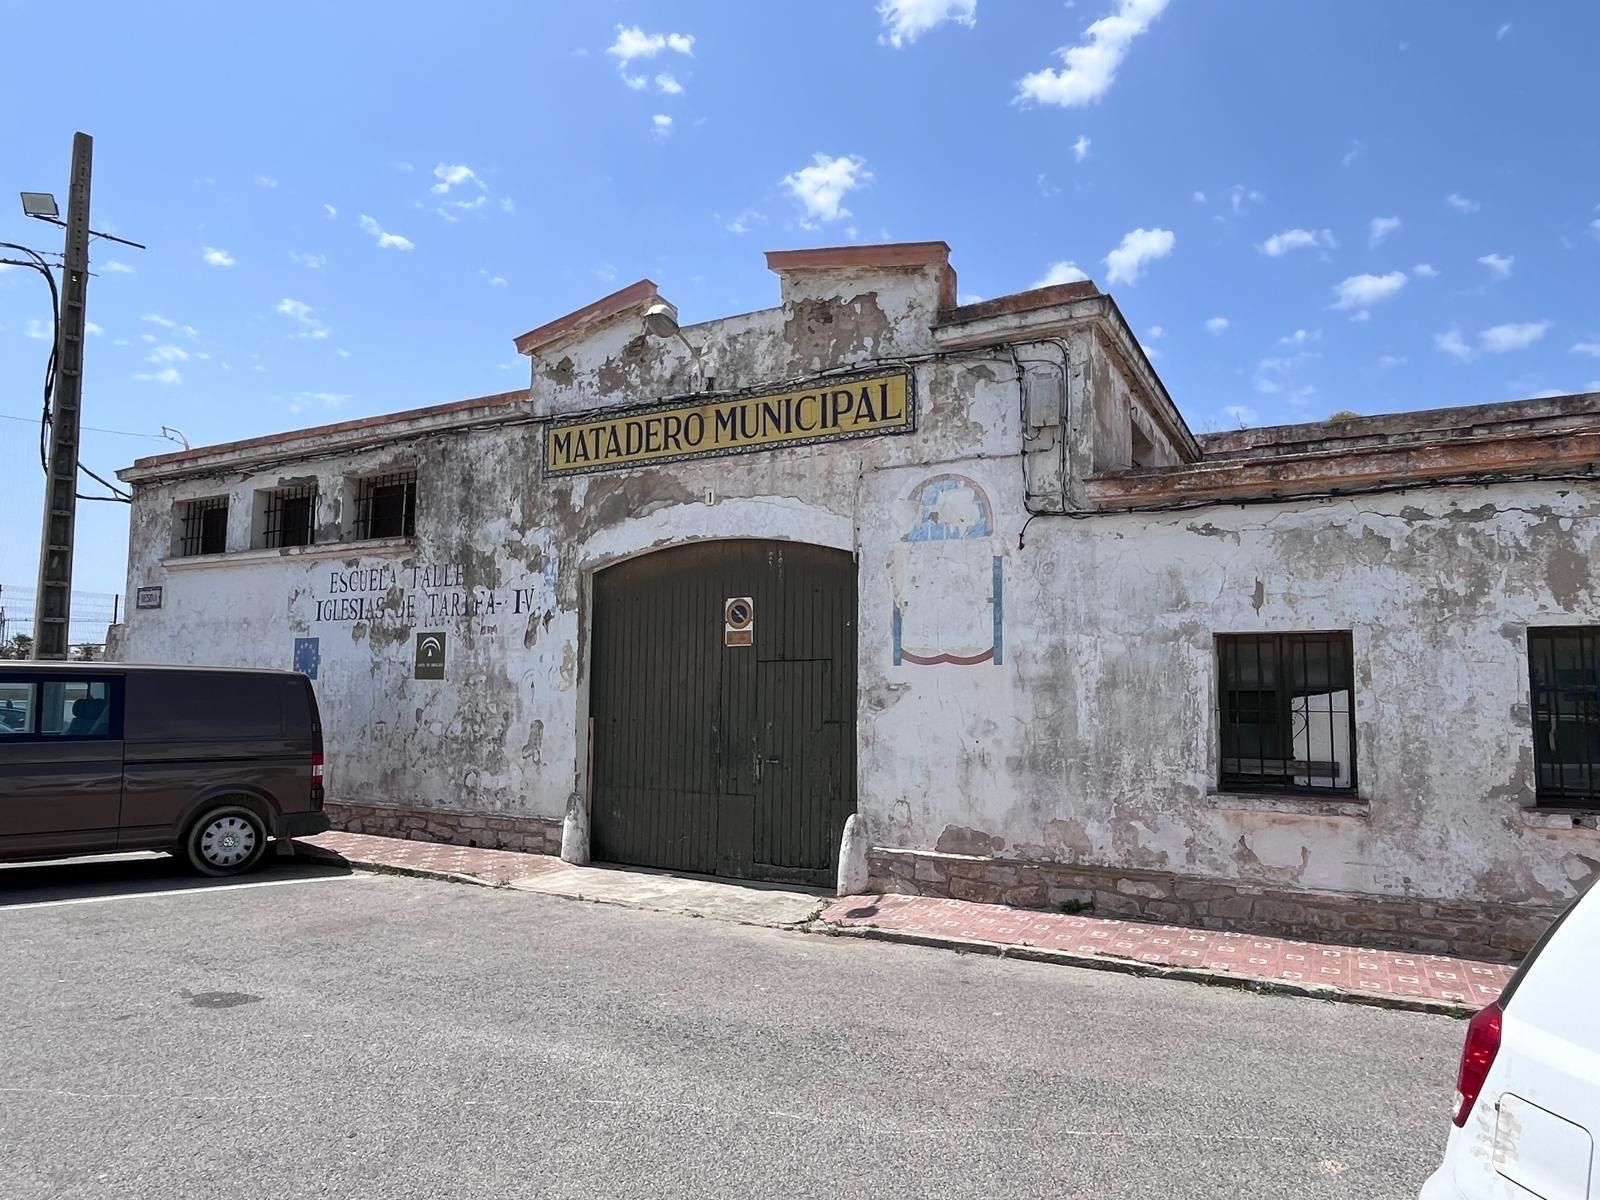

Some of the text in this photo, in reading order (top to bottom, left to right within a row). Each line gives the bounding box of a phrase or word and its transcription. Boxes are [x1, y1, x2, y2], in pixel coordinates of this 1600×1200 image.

[551, 383, 902, 466] MATADERO MUNICIPAL
[330, 568, 396, 594] ESCUELA
[315, 596, 386, 622] IGLESIAS
